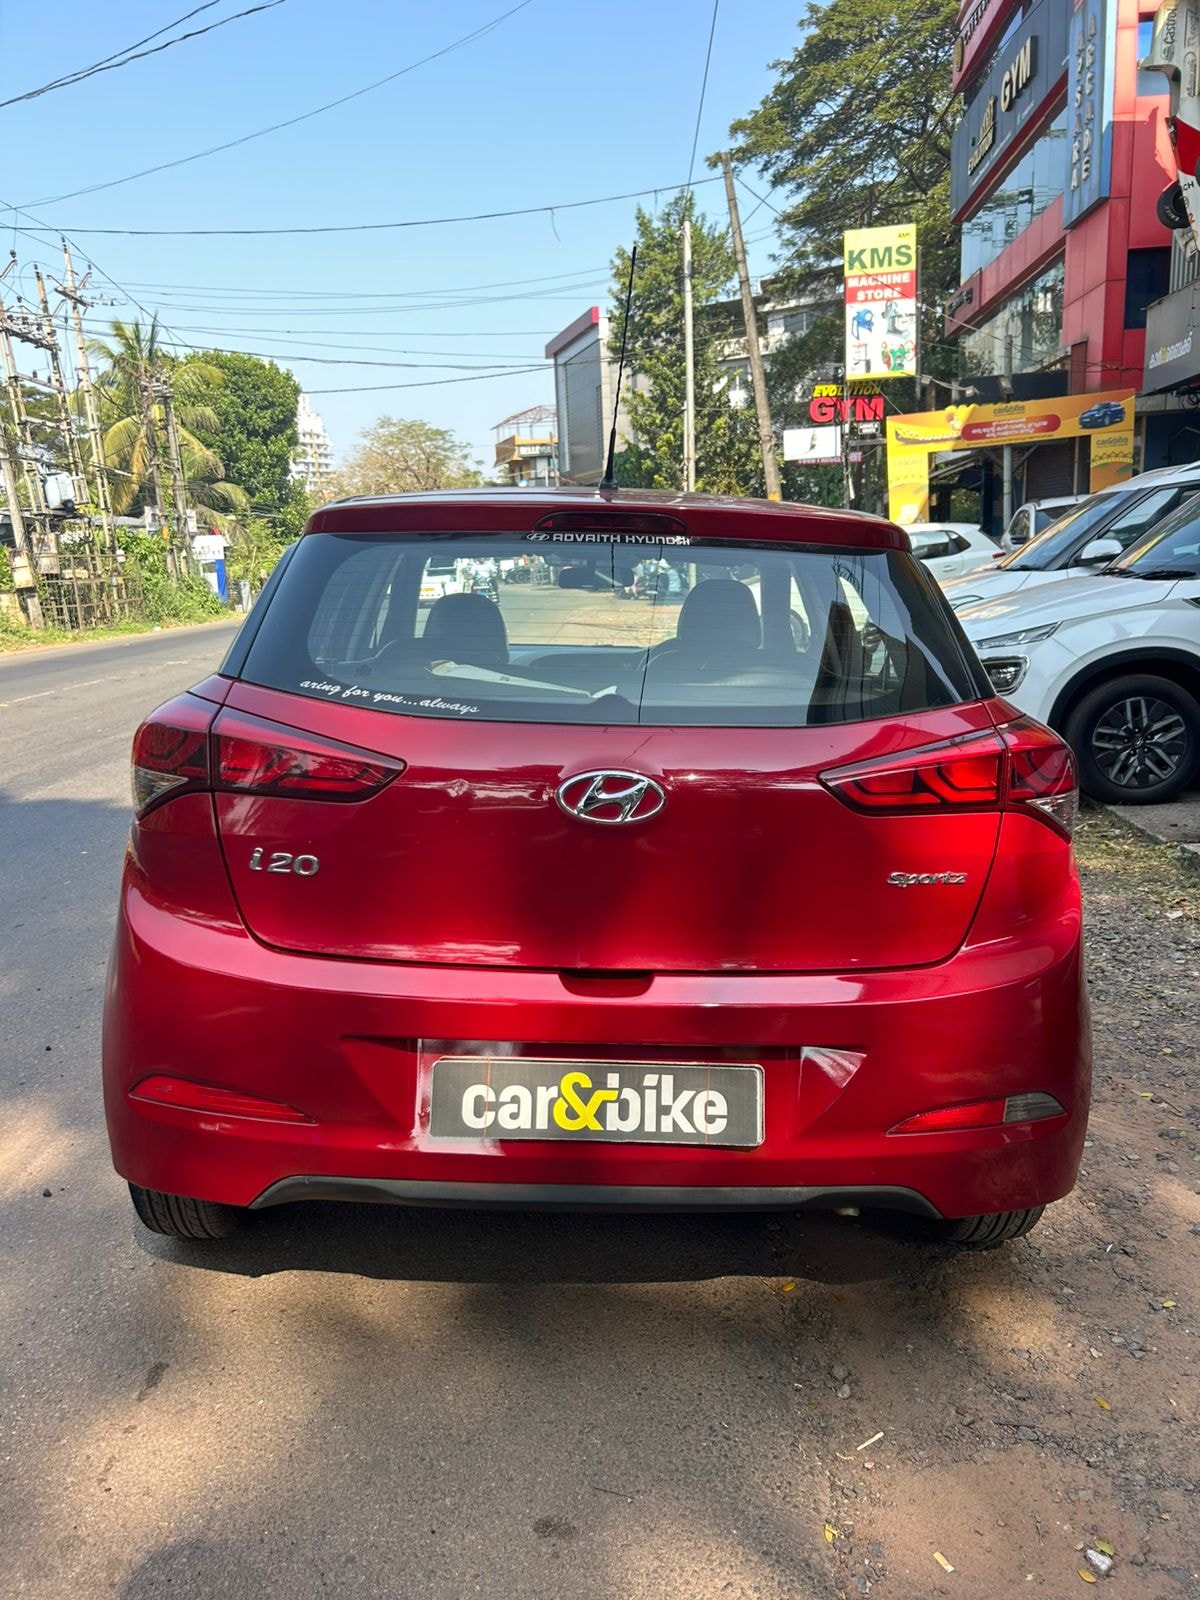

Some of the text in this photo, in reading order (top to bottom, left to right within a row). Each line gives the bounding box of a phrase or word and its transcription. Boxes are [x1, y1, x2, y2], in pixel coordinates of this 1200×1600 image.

[1000, 35, 1034, 113] GYM
[847, 244, 913, 270] KMS
[847, 272, 911, 288] MACHINE
[856, 287, 902, 301] STORE
[809, 396, 884, 422] GYM
[552, 533, 621, 543] ADVAITH
[342, 685, 370, 698] for
[249, 847, 320, 876] i20
[886, 870, 968, 888] Sportz
[461, 1071, 728, 1135] car&bike
